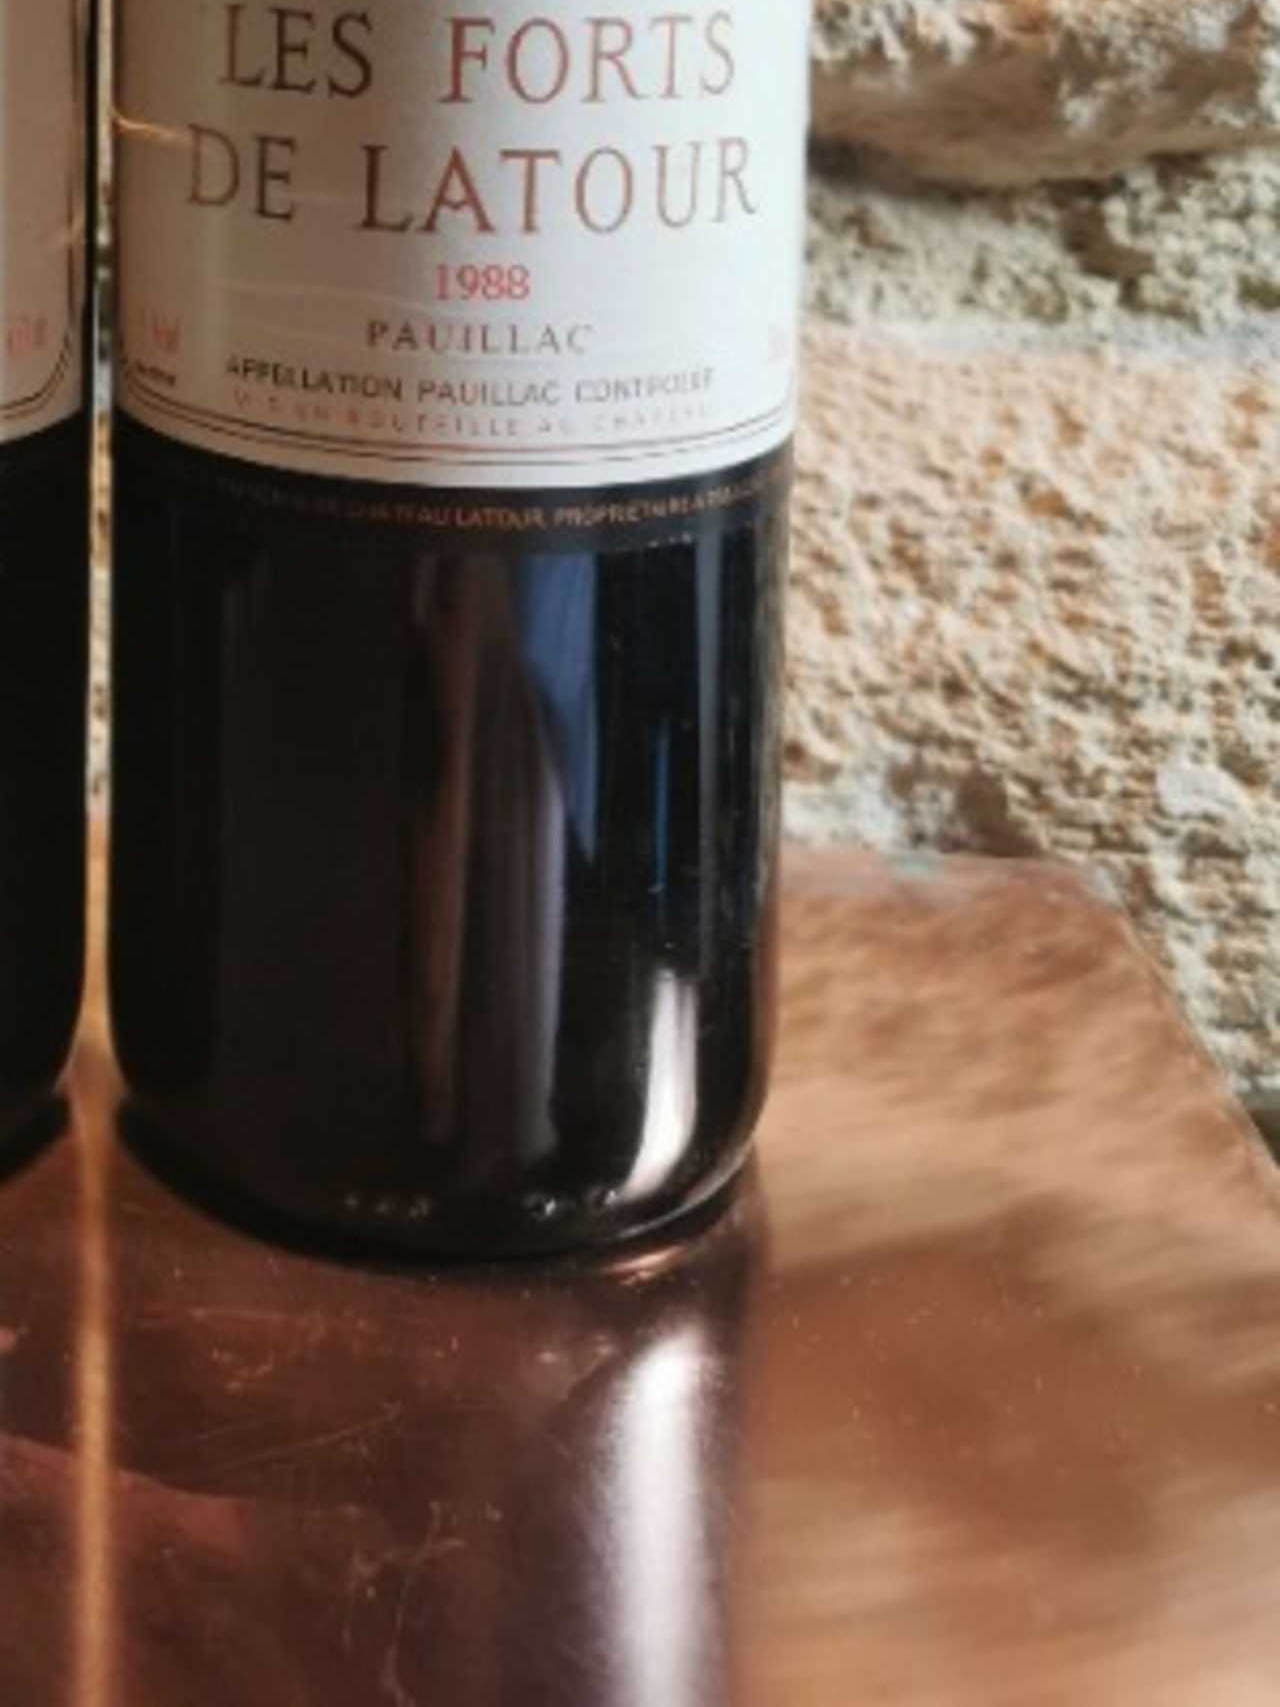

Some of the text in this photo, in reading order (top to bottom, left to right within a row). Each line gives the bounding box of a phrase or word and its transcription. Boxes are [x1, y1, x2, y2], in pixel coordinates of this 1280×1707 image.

[222, 3, 736, 105] LES FORTS
[186, 123, 758, 235] DE LATOUR
[435, 263, 531, 302] 1988
[366, 318, 594, 356] PAUILLAC
[226, 356, 402, 402] APPELLATION
[418, 379, 562, 407] PAUILLAC
